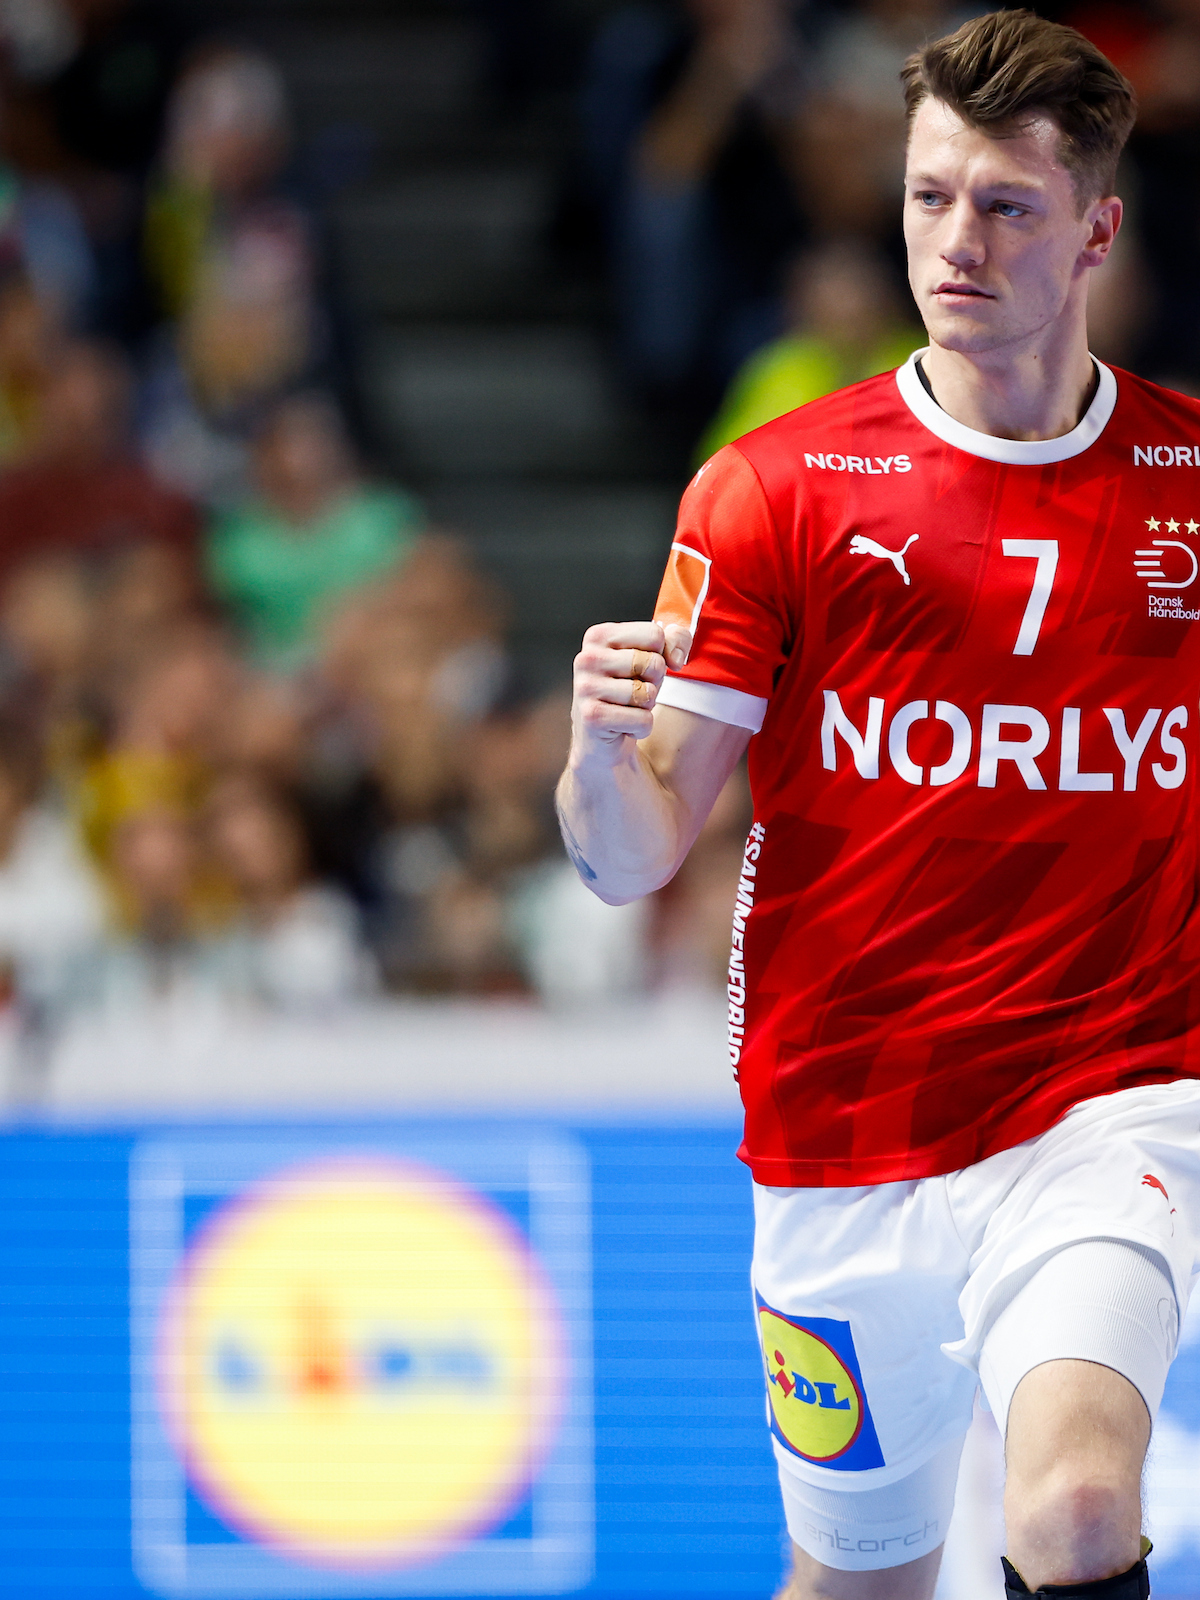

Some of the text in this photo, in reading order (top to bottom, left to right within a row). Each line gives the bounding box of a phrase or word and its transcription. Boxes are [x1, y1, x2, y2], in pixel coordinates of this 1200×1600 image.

[804, 452, 912, 475] NORLYS
[1001, 538, 1060, 656] 7
[1148, 594, 1184, 608] Dansk
[1148, 606, 1200, 621] Håndbold
[820, 689, 1188, 792] NORLYS
